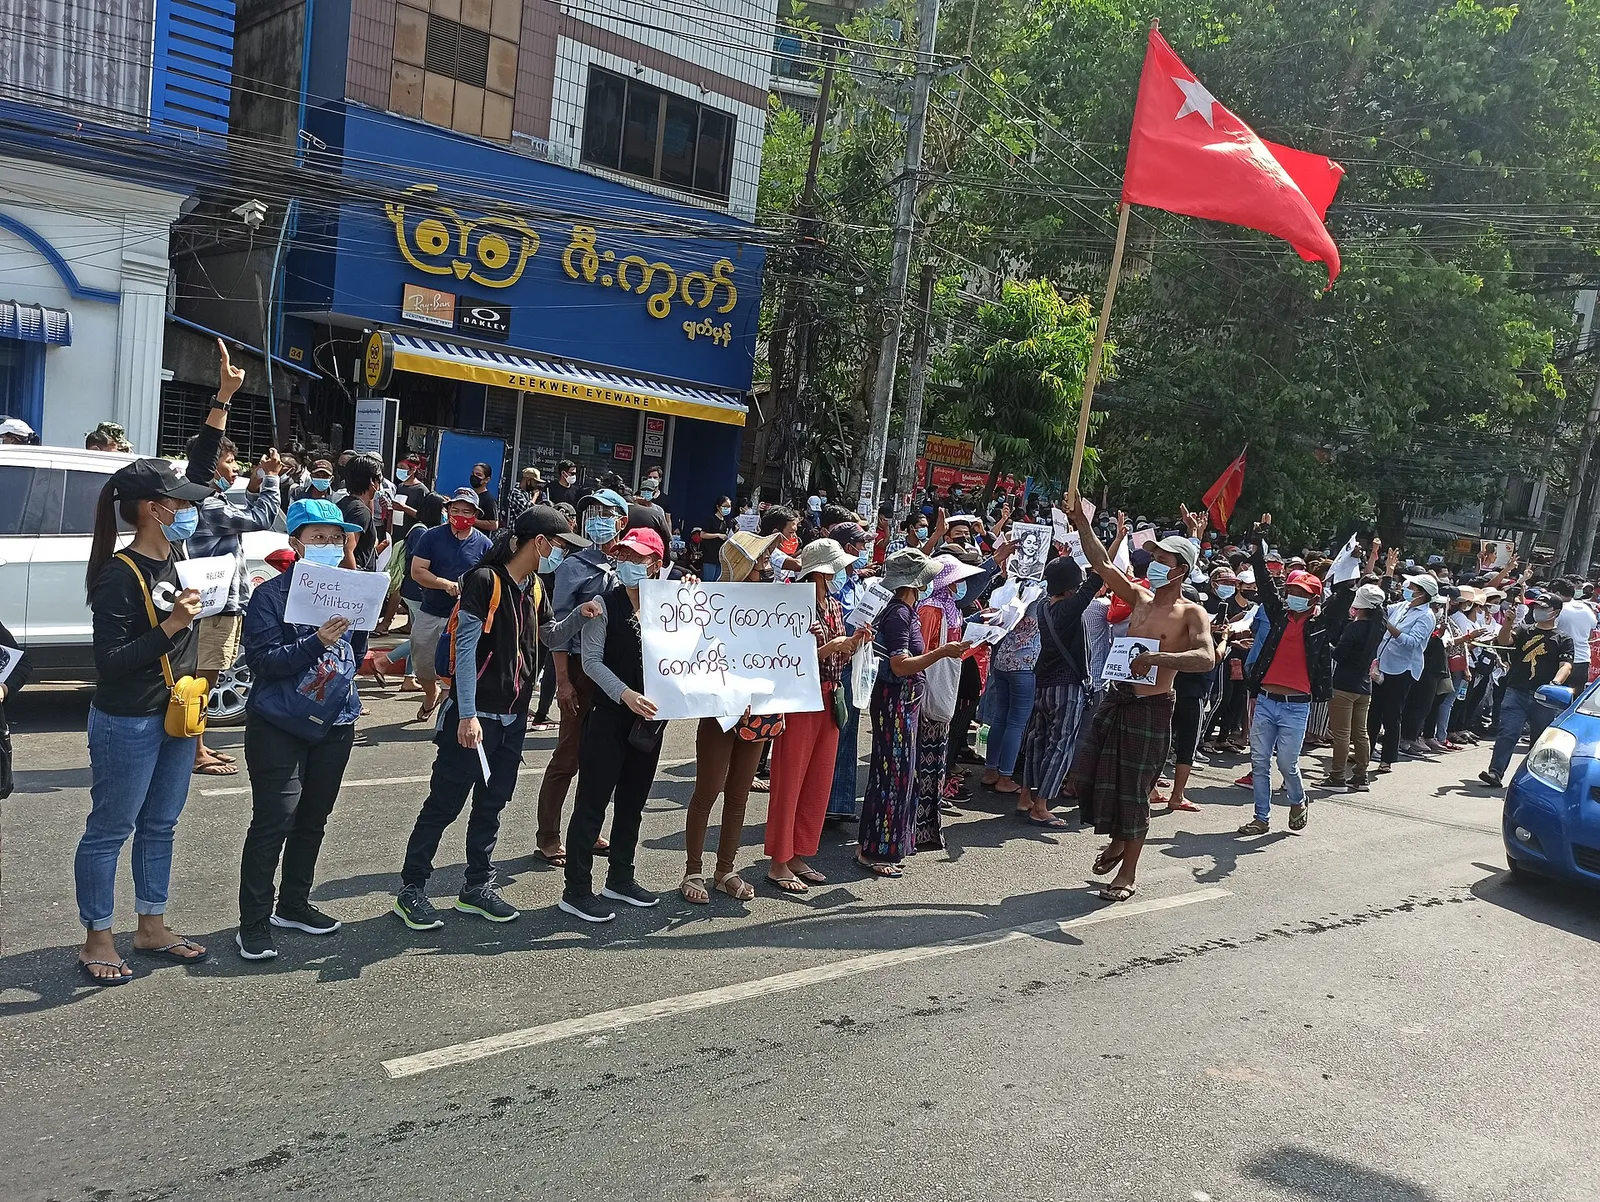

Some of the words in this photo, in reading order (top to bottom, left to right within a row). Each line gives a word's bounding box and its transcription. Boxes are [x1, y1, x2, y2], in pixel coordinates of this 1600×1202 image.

[463, 316, 507, 331] OAKLEY
[291, 349, 302, 359] 34
[508, 374, 579, 395] ZEEKWEK
[586, 388, 650, 407] EYEWARE
[299, 572, 341, 595] Reject
[313, 593, 364, 614] Military
[1106, 663, 1122, 672] FREE
